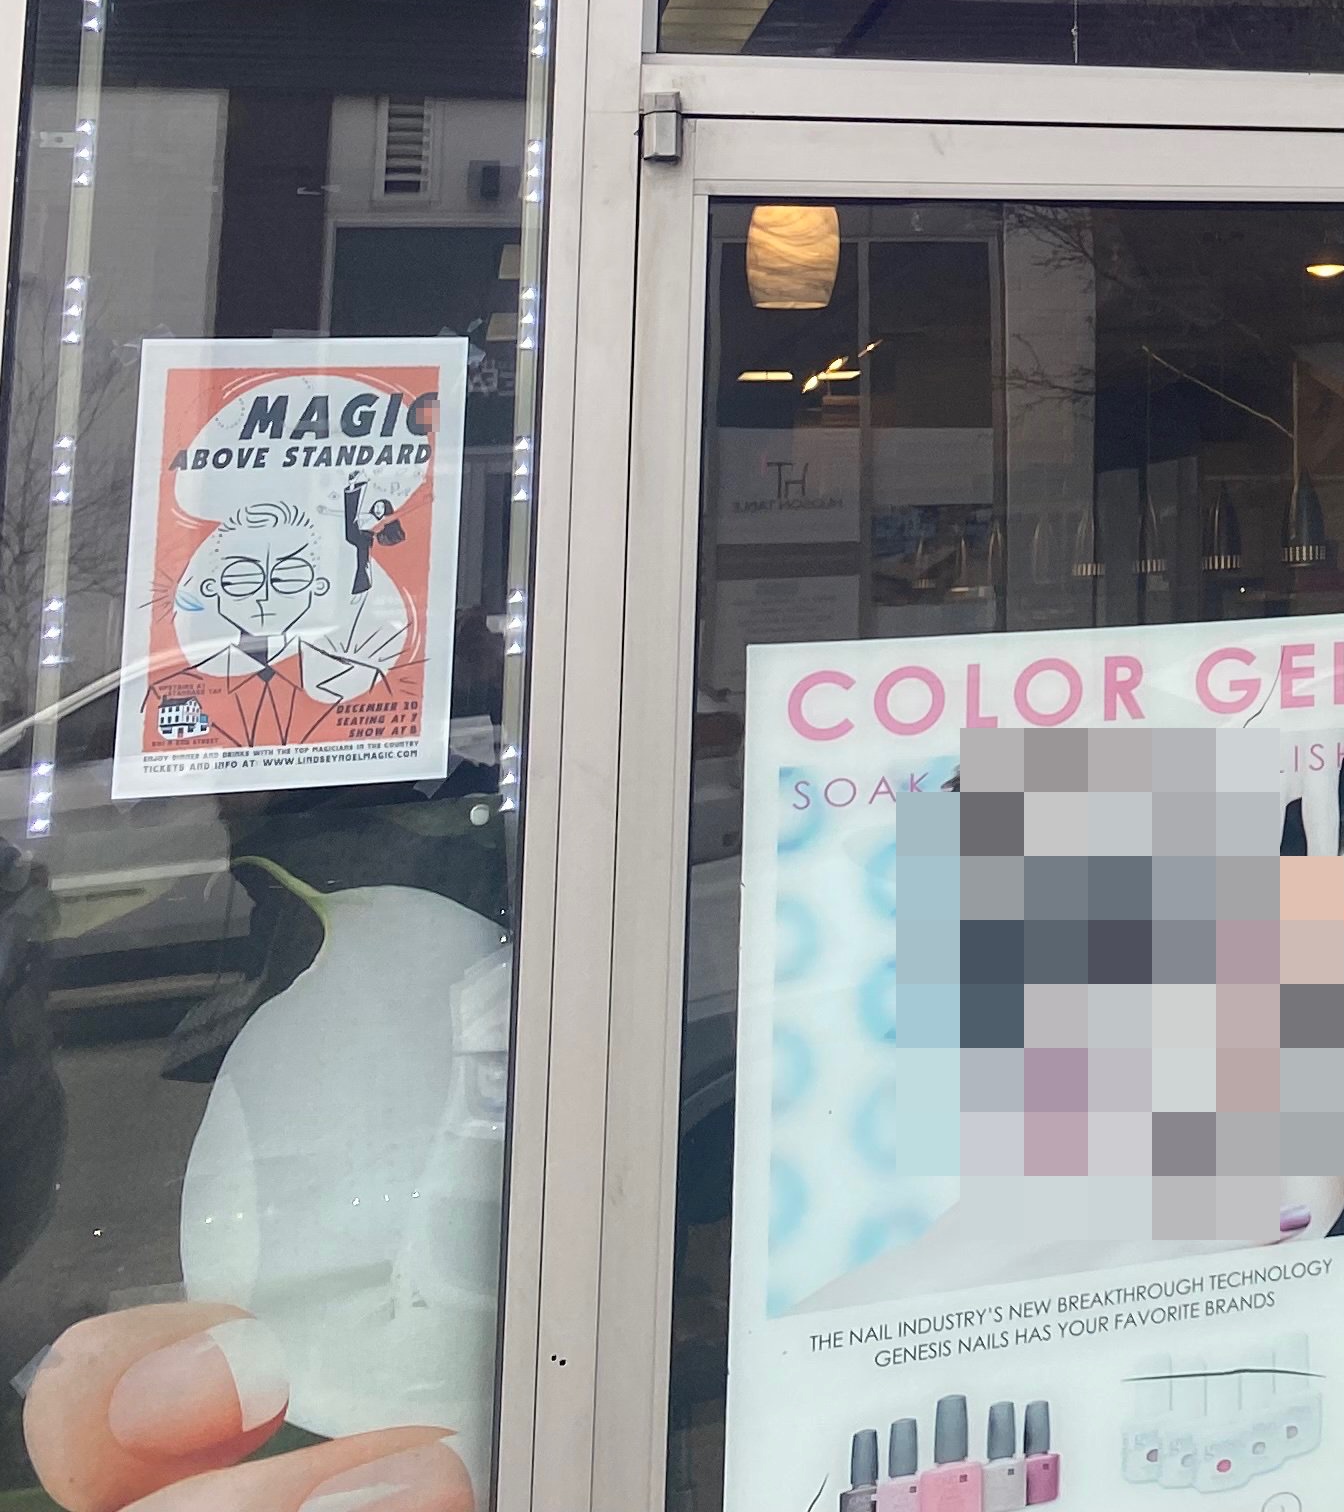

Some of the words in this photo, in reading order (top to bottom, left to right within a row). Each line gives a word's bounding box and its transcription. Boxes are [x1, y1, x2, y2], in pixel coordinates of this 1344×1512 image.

[239, 392, 439, 441] MAGIC
[169, 447, 269, 471] ABOVE
[282, 443, 431, 468] STANDARD
[336, 702, 398, 714] DECEMBER
[788, 655, 1145, 741] COLOR
[336, 715, 385, 726] SEATING
[391, 714, 405, 723] AT
[349, 728, 385, 737] SHOW
[391, 726, 408, 735] AT
[384, 740, 419, 748] COUNTRY
[143, 763, 184, 773] TICKETS
[190, 762, 210, 770] AND
[215, 760, 238, 769] INFO
[792, 771, 930, 811] SOAK
[810, 1331, 844, 1352] THE
[850, 1323, 893, 1346] NAIL
[899, 1306, 1003, 1338] INDUSTRY'S
[1009, 1299, 1052, 1320] NEW
[1058, 1277, 1203, 1313] BREAKTHROUGH
[1209, 1258, 1333, 1290] TECHNOLOGY
[874, 1340, 951, 1367] GENESIS
[958, 1331, 1009, 1354] NAILS
[1015, 1324, 1052, 1345] HAS
[1058, 1316, 1109, 1338] YOUR
[1115, 1302, 1200, 1330] FAVORITE
[1205, 1291, 1275, 1316] BRANDS
